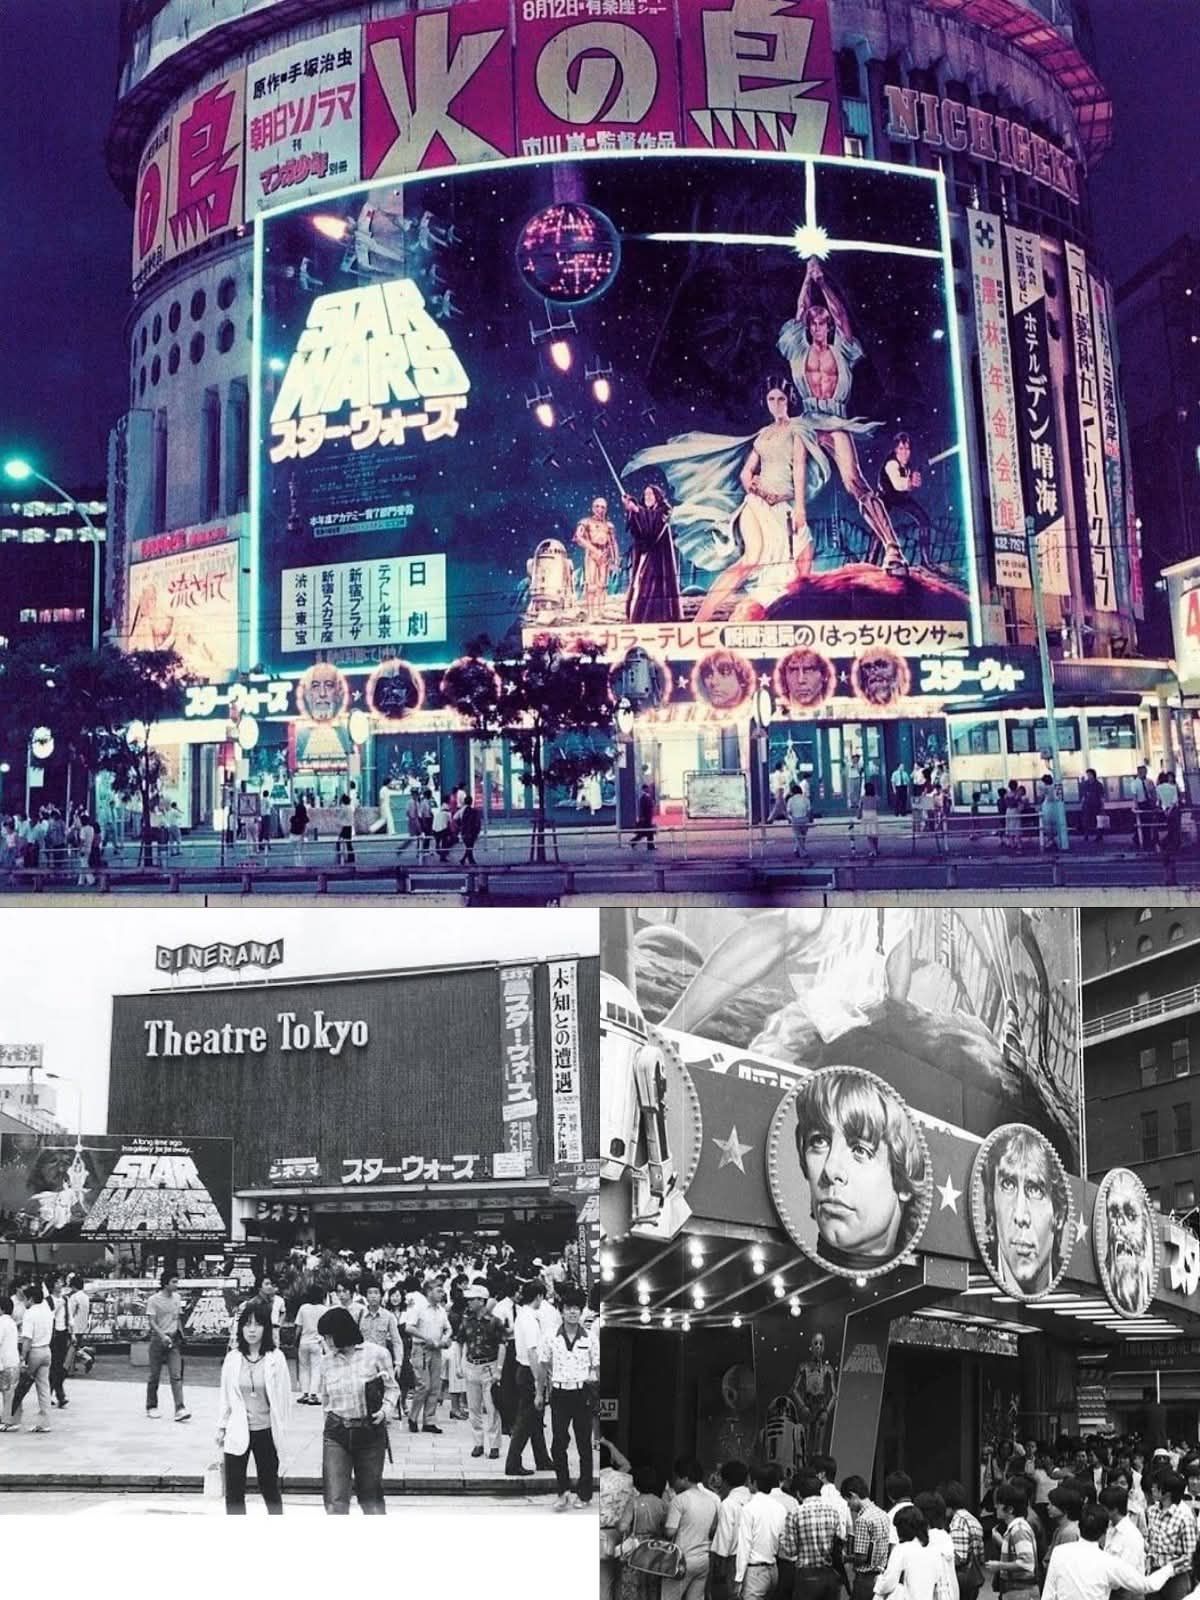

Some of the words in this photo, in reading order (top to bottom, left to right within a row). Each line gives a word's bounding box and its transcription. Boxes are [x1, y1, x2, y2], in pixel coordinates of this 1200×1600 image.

[250, 82, 356, 151] 朝日ソノラマ
[884, 85, 1080, 205] NICHIGEKI
[298, 277, 448, 348] STAR
[270, 334, 471, 423] WARS
[294, 572, 309, 646] 渋谷東宝
[320, 569, 335, 644] 新宿スカラ座
[349, 567, 365, 641] 新宿プラザ
[377, 564, 392, 639] テアトル東京
[406, 561, 429, 637] 日劇
[157, 943, 281, 970] CINERAMA
[144, 1020, 268, 1057] Theatre
[277, 1010, 369, 1056] Tokyo
[553, 967, 573, 1094] 未知との遭遇
[81, 1188, 227, 1231] WARS
[104, 1155, 207, 1190] STAR
